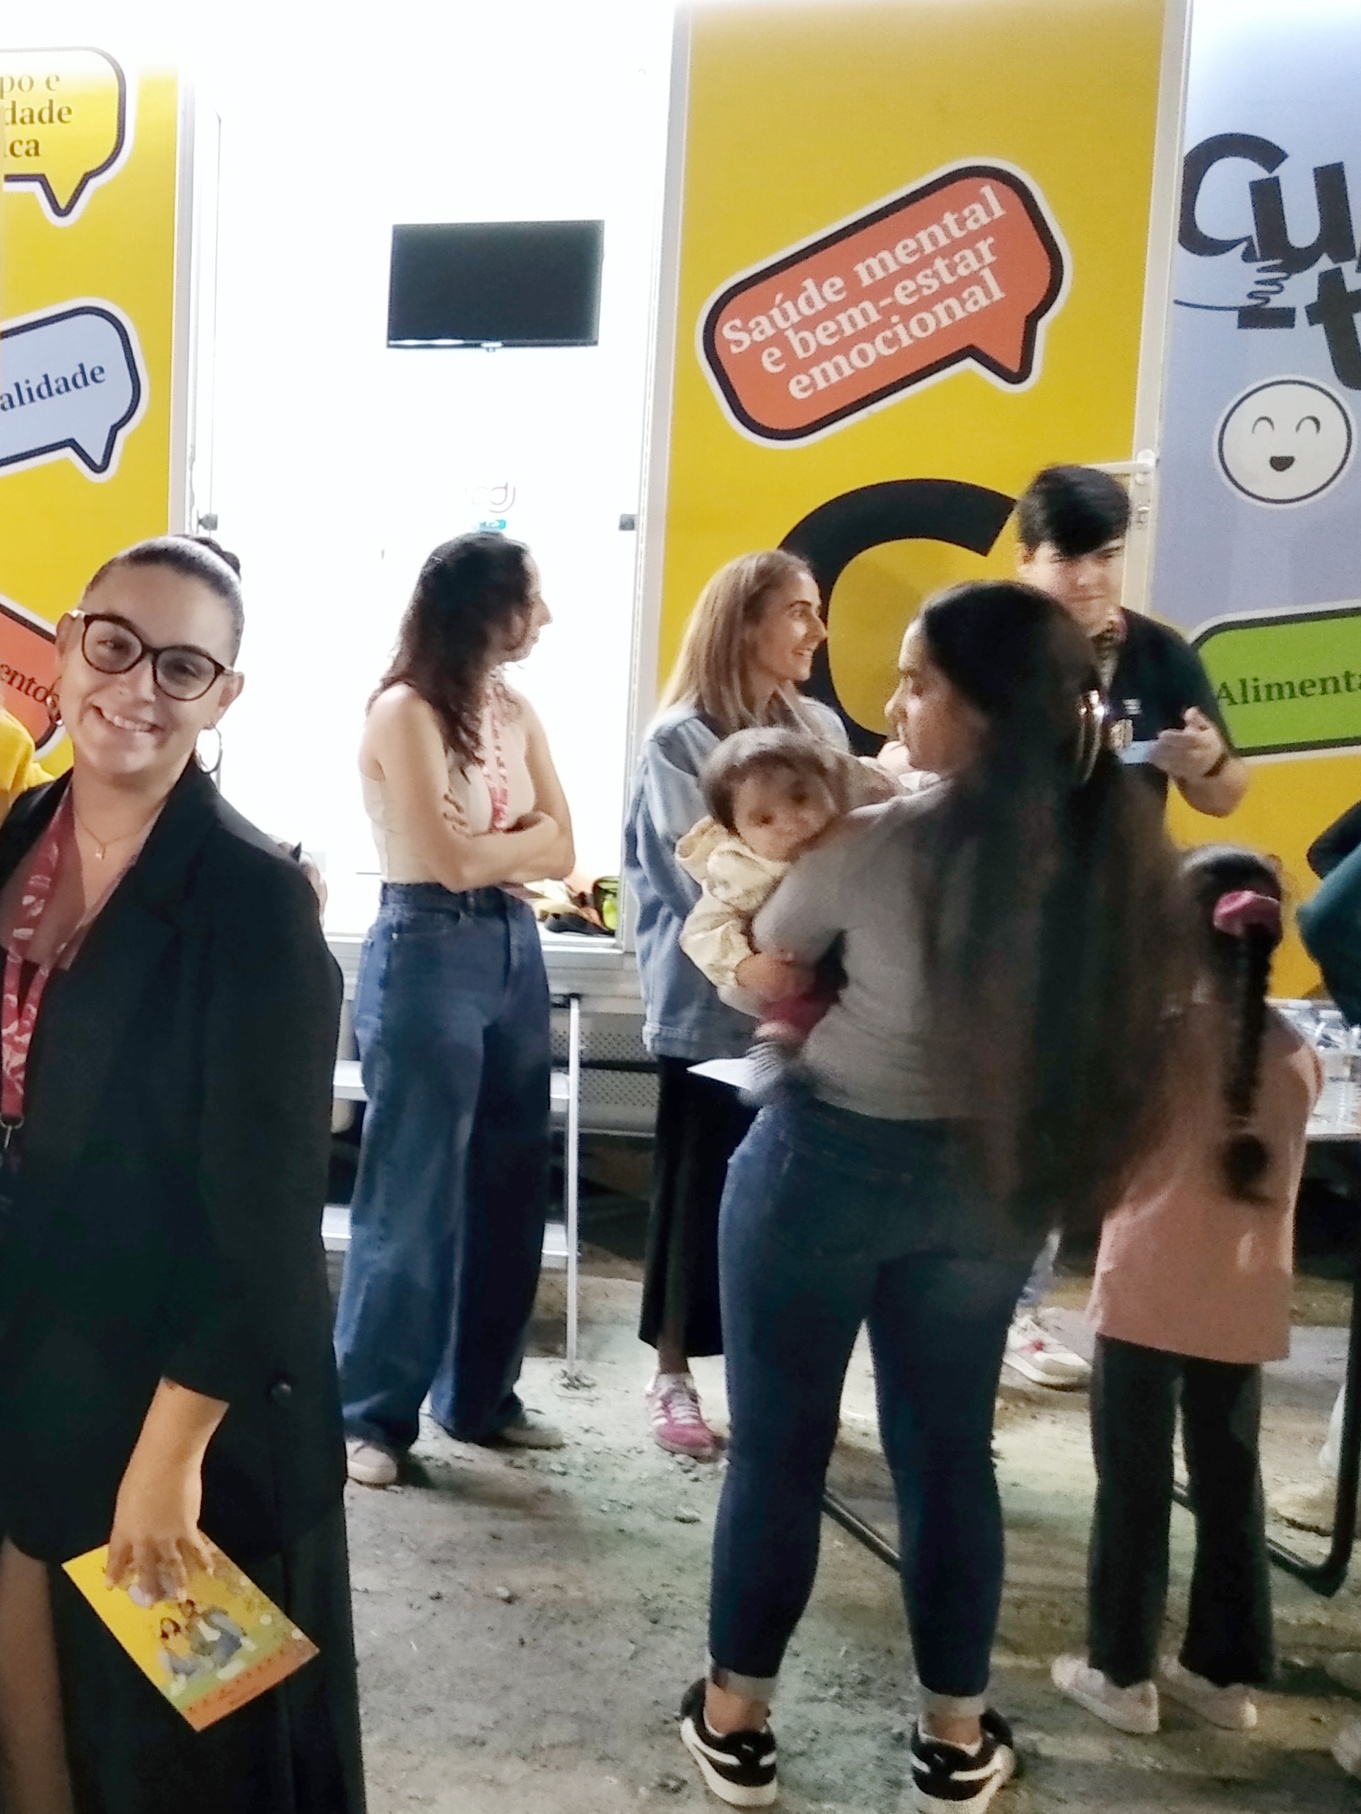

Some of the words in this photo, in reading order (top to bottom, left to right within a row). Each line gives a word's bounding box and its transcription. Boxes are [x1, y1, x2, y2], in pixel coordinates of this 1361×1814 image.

[45, 73, 60, 91] e
[3, 138, 41, 158] ca
[722, 277, 847, 354] Saúde
[853, 184, 1007, 288] mental
[761, 345, 787, 374] e
[784, 236, 998, 360] bem-estar
[788, 267, 1007, 399] emocional
[1217, 670, 1361, 706] Aliment
